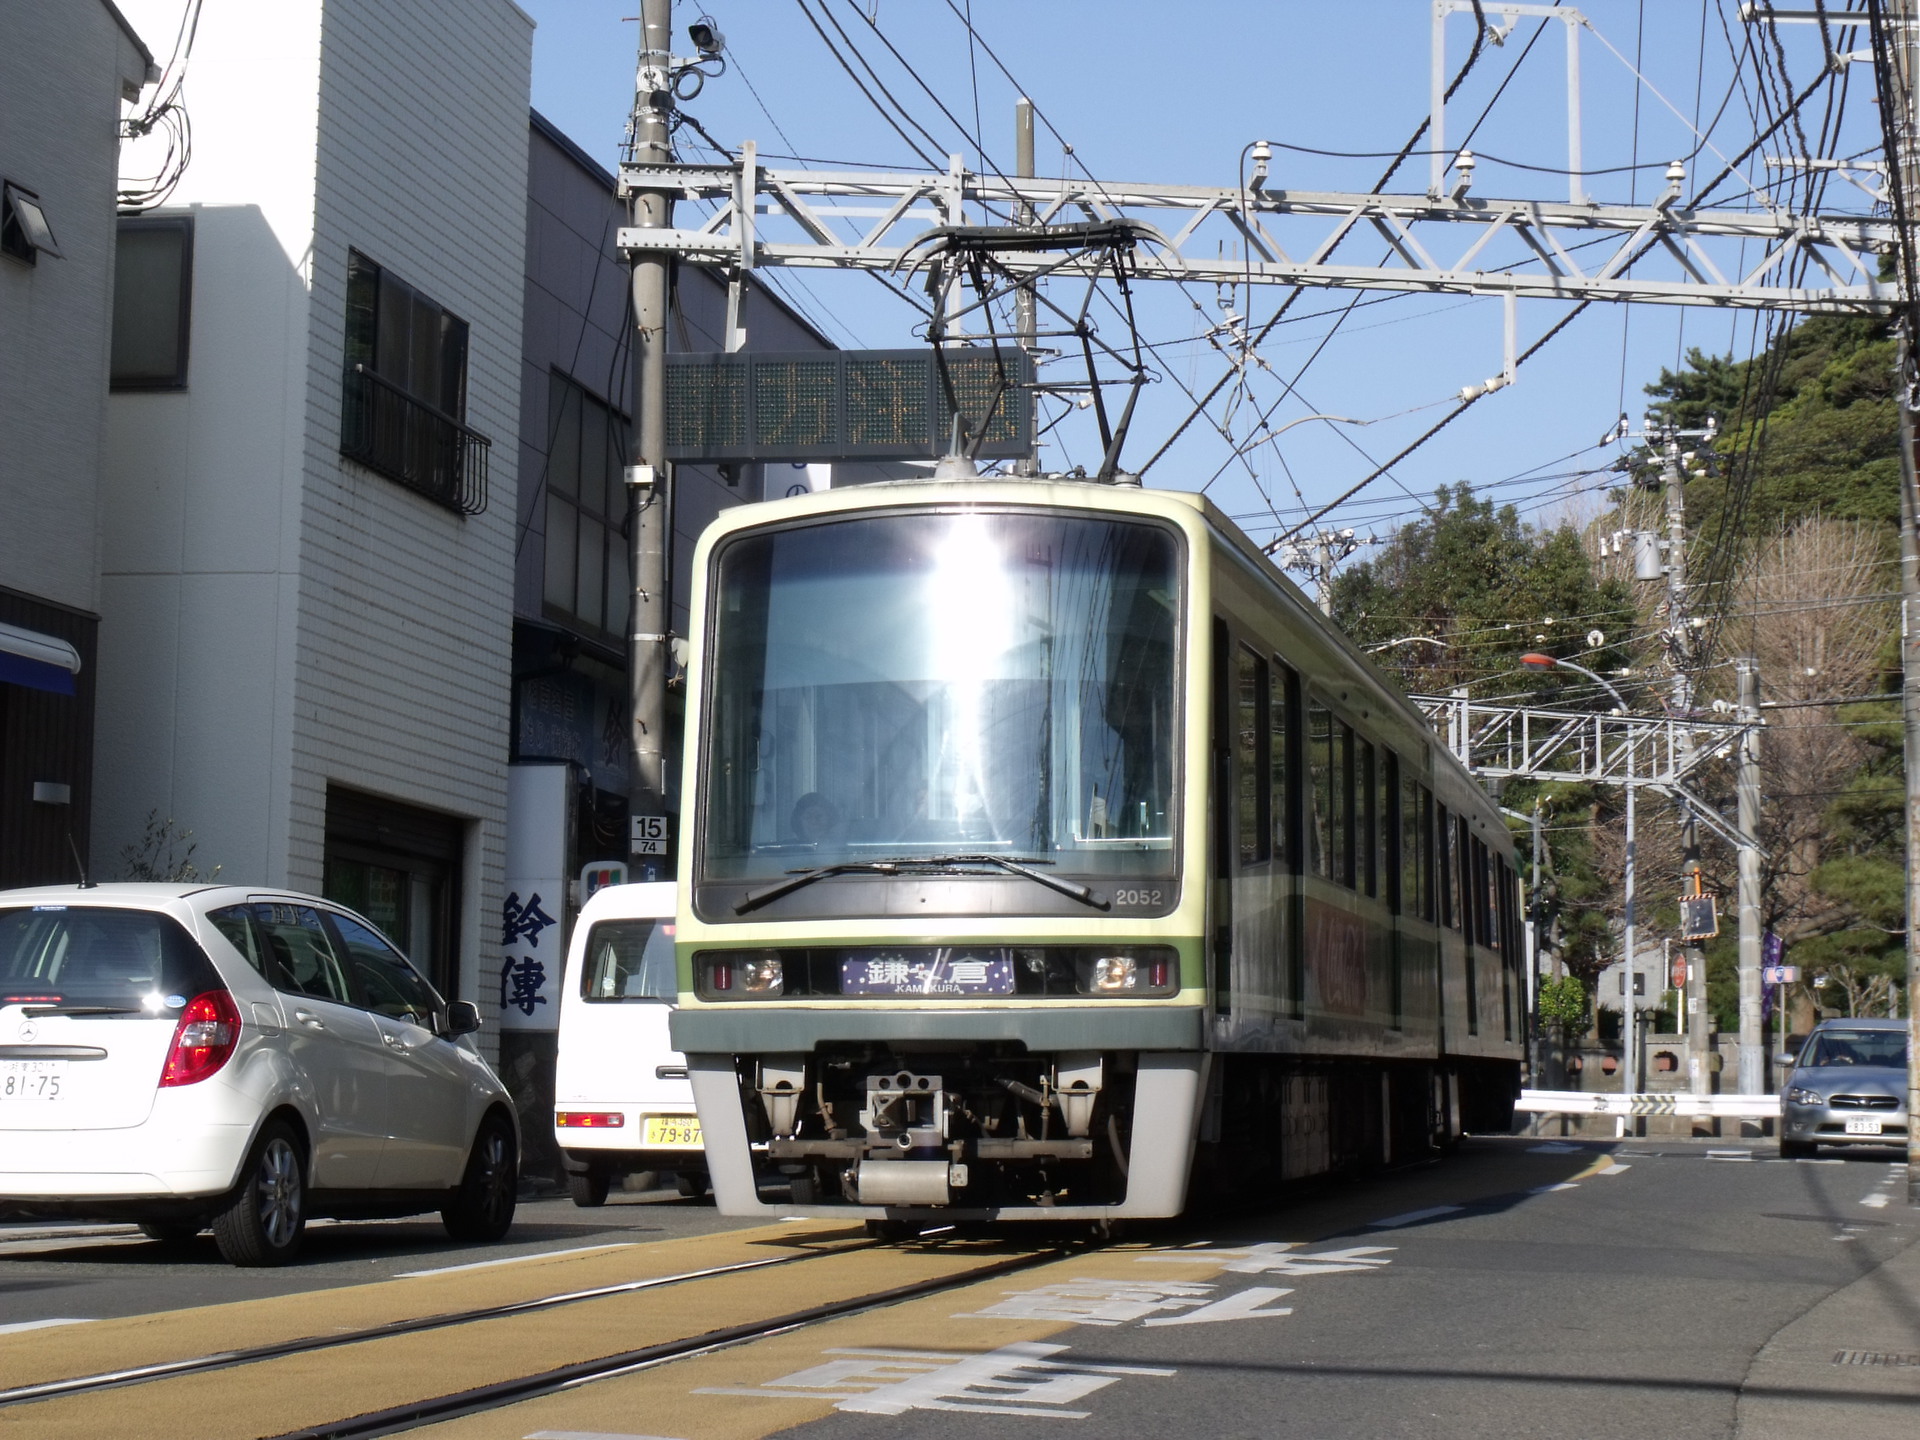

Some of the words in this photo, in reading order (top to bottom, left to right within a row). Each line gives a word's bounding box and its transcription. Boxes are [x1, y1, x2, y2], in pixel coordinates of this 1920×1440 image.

[636, 818, 662, 839] 15
[641, 842, 657, 853] 74
[1116, 889, 1162, 907] 2052
[867, 956, 990, 985] 鎌倉
[659, 1127, 702, 1143] 79-87
